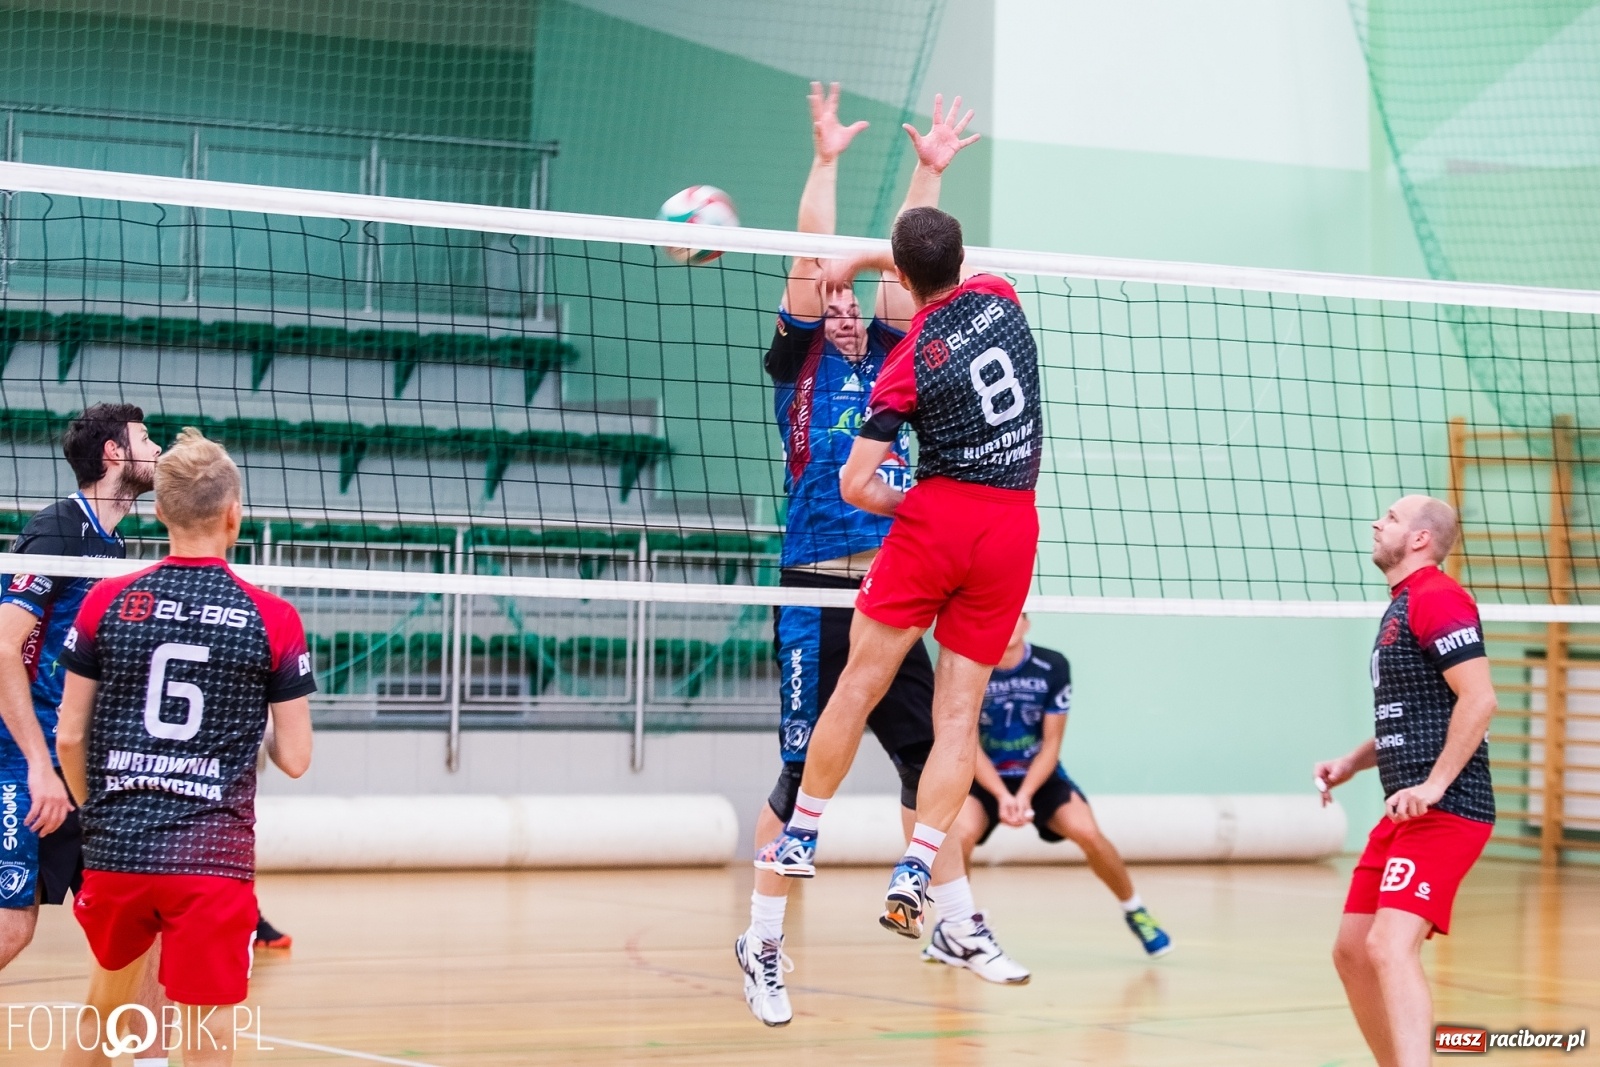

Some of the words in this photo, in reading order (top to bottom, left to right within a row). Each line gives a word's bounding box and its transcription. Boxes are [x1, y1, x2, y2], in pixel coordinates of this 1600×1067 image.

[946, 302, 1004, 351] EL-BIS
[969, 347, 1025, 427] 8
[154, 599, 252, 628] EL-BIS
[1434, 626, 1480, 656] ENTER
[144, 642, 210, 741] 6
[106, 750, 220, 778] HURTOWNIA
